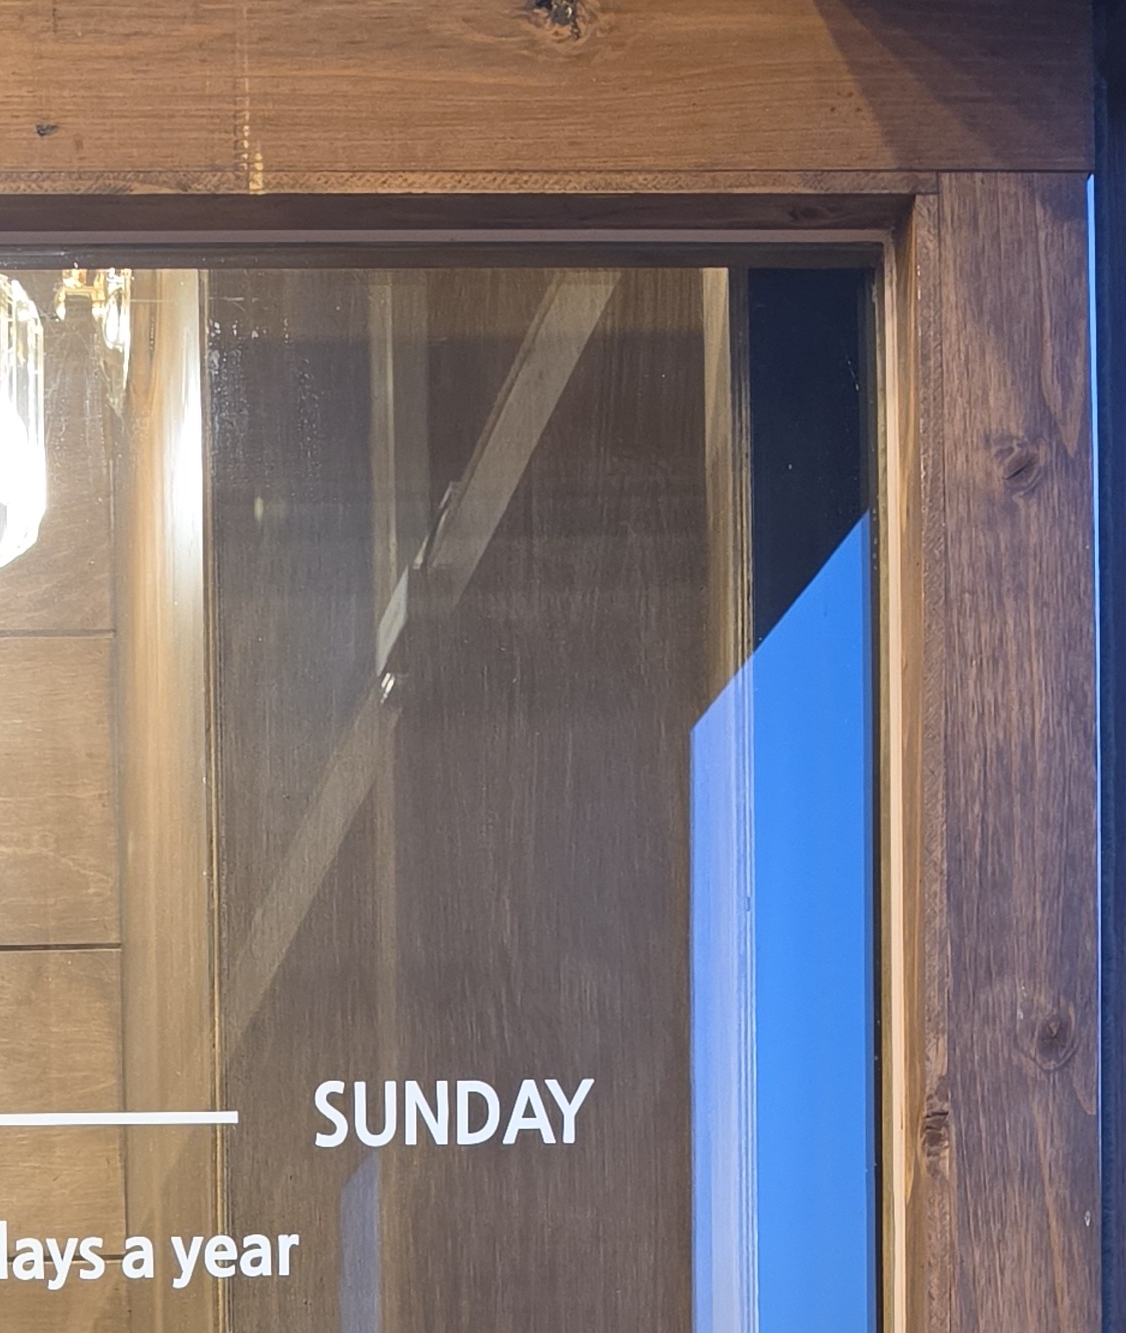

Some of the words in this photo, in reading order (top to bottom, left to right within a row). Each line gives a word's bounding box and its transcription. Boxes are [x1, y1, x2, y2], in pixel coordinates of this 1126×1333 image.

[314, 1079, 594, 1148] SUNDAY
[122, 1237, 155, 1279] a
[171, 1234, 299, 1288] year
